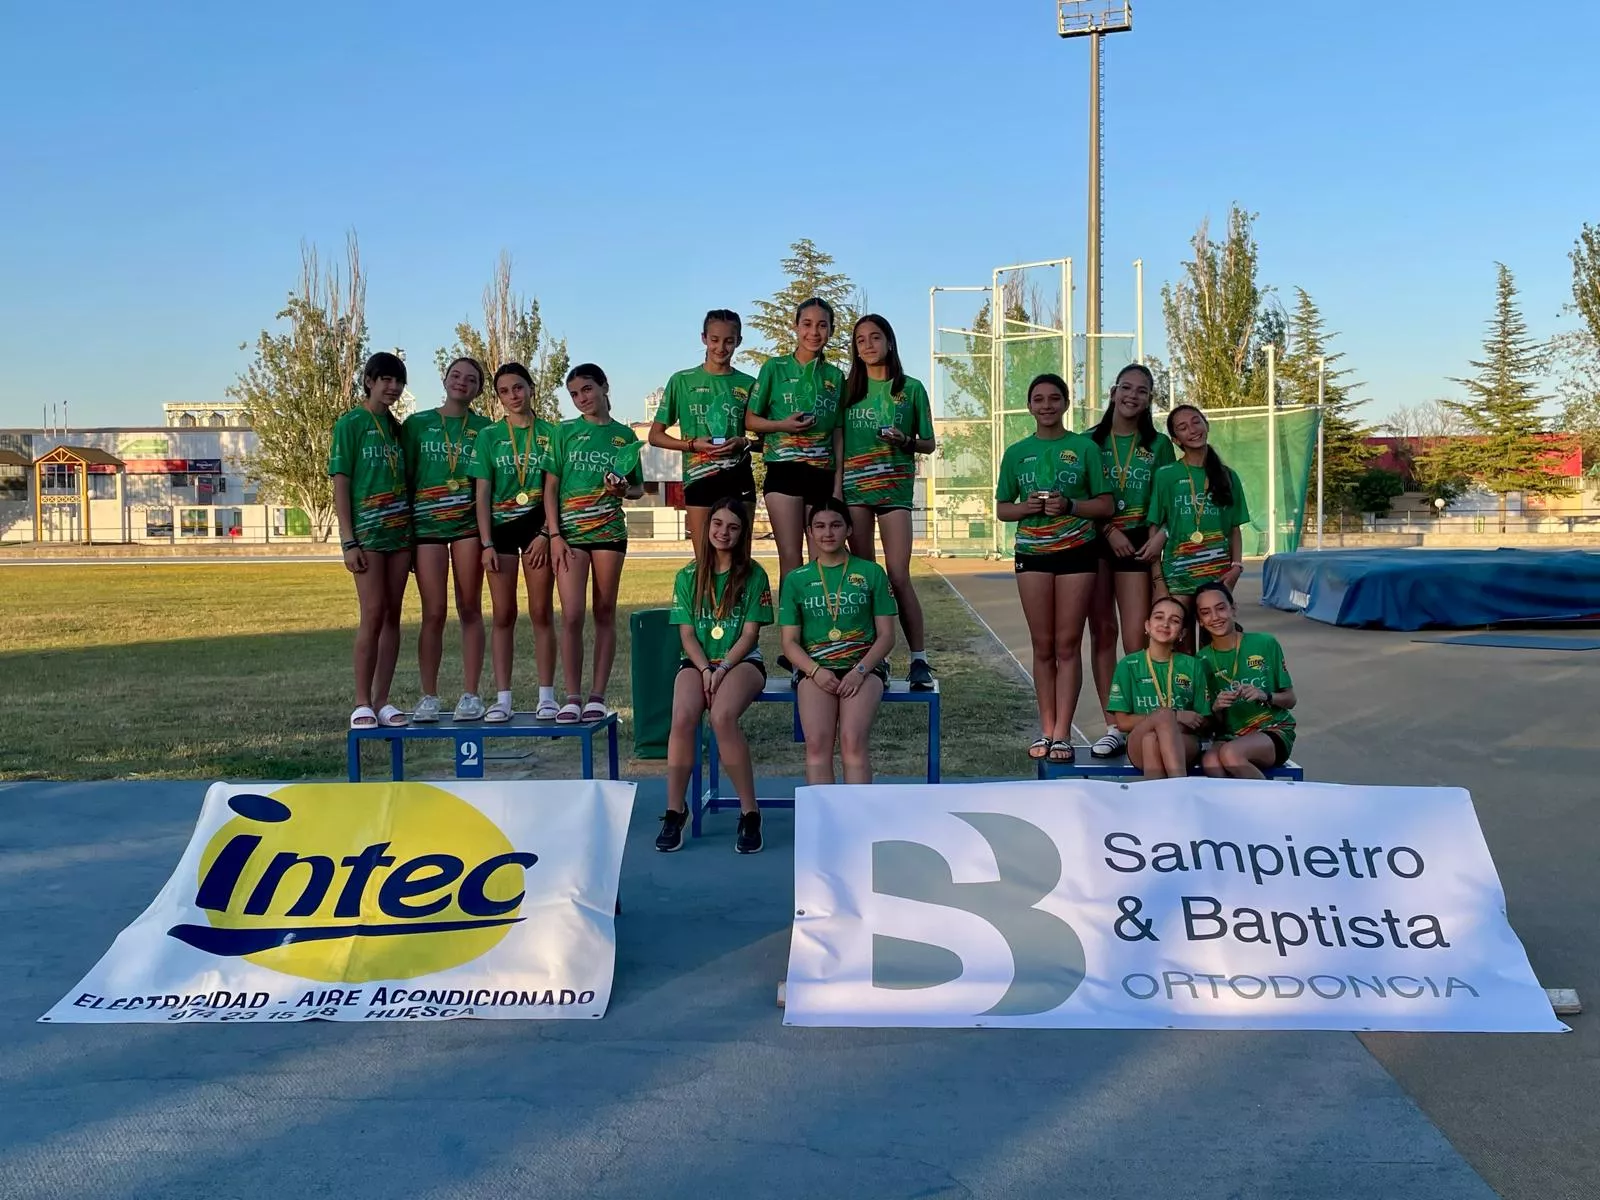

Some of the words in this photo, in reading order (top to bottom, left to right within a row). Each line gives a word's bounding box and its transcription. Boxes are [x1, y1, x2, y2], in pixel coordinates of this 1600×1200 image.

[461, 741, 478, 766] 2
[195, 794, 539, 918] intec
[1104, 832, 1425, 885] Sampietro
[1113, 895, 1160, 942] &
[1180, 895, 1451, 957] Baptista
[296, 989, 363, 1008] AIRE
[1121, 971, 1481, 1000] ORTODONCIA
[268, 1011, 297, 1020] 15
[364, 1006, 475, 1018] HUESCA
